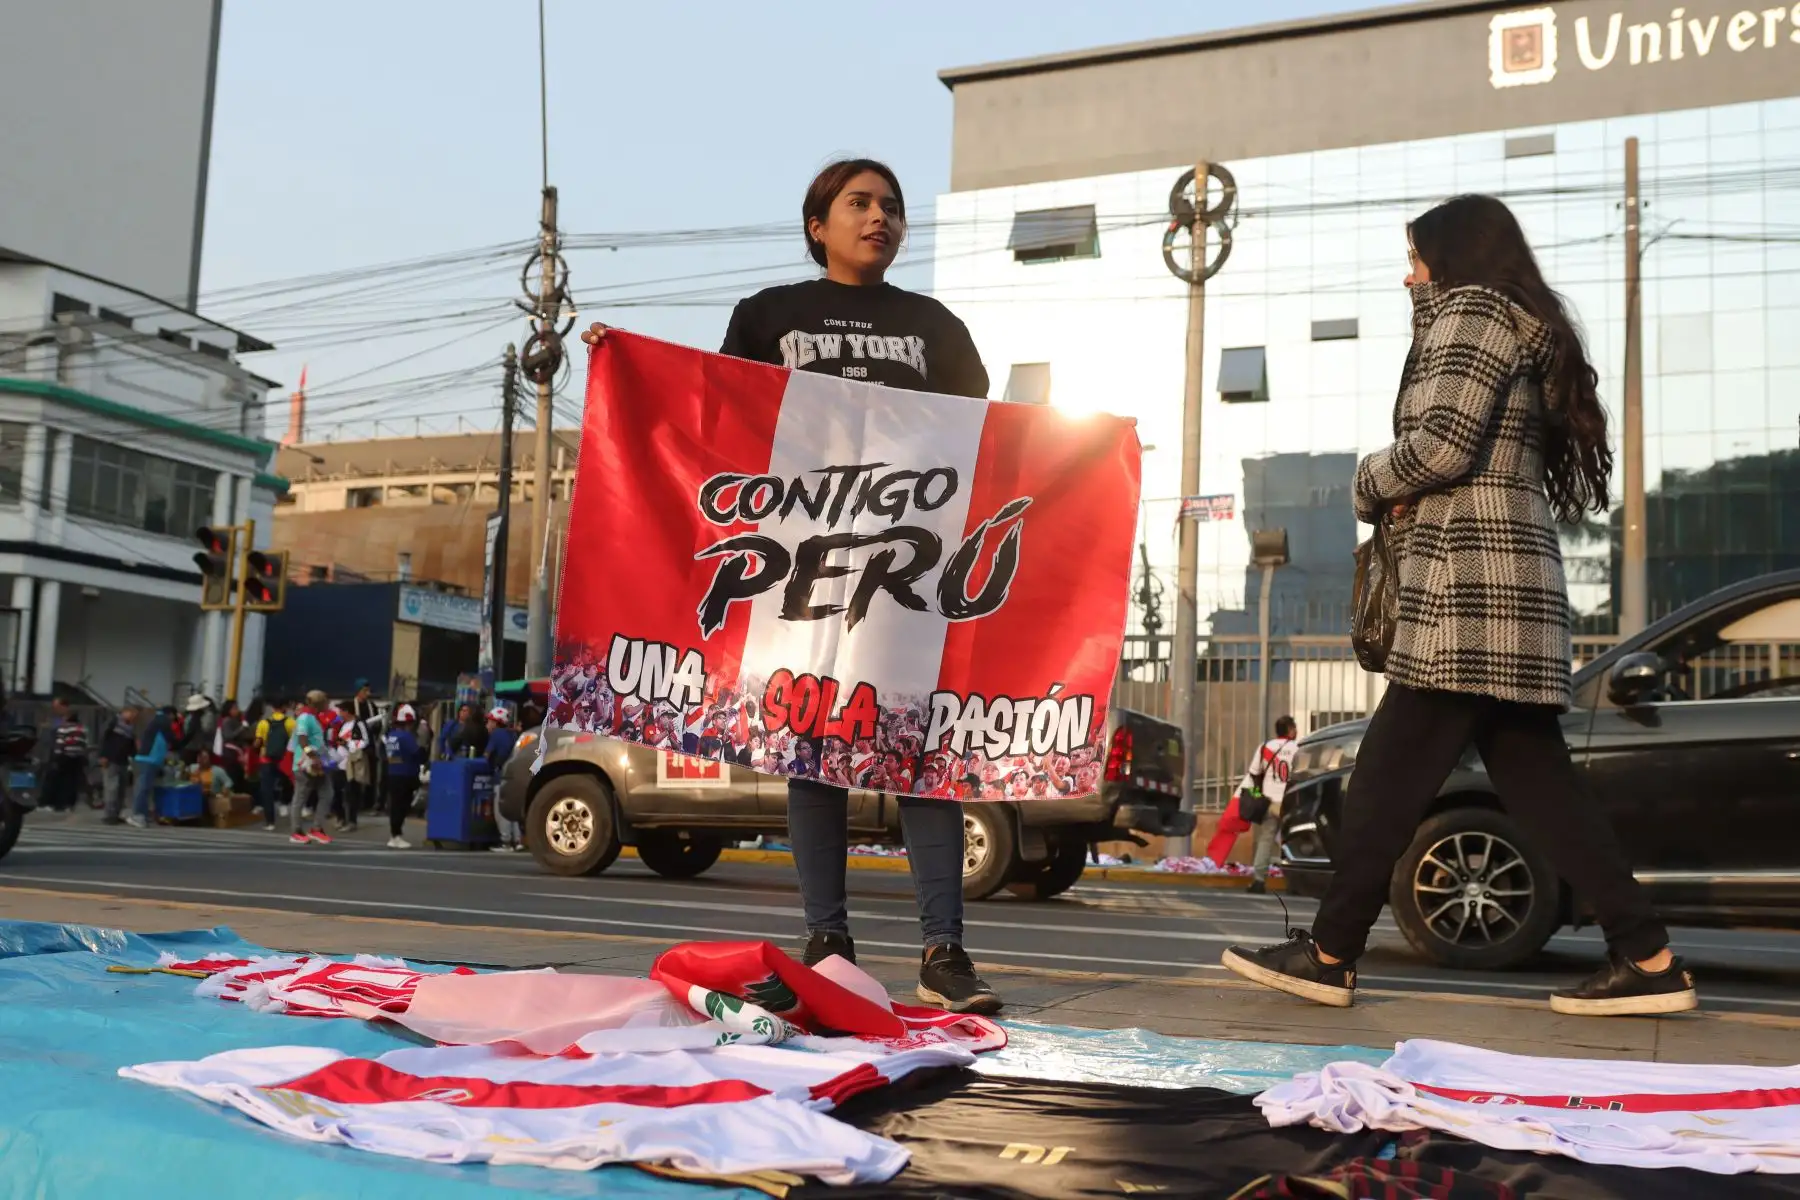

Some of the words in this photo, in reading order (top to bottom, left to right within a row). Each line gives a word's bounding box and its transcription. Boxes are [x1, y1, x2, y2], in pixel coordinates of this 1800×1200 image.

[823, 318, 847, 327] COME
[849, 320, 873, 329] TRUE
[779, 329, 842, 370] NEW
[845, 333, 928, 381] YORK
[841, 366, 868, 378] 1968
[699, 462, 958, 527] CONTIGO
[694, 496, 1034, 641] PERÚ
[606, 633, 707, 710] UNA
[759, 668, 878, 744] SOLA
[923, 682, 1095, 761] PASIÓN
